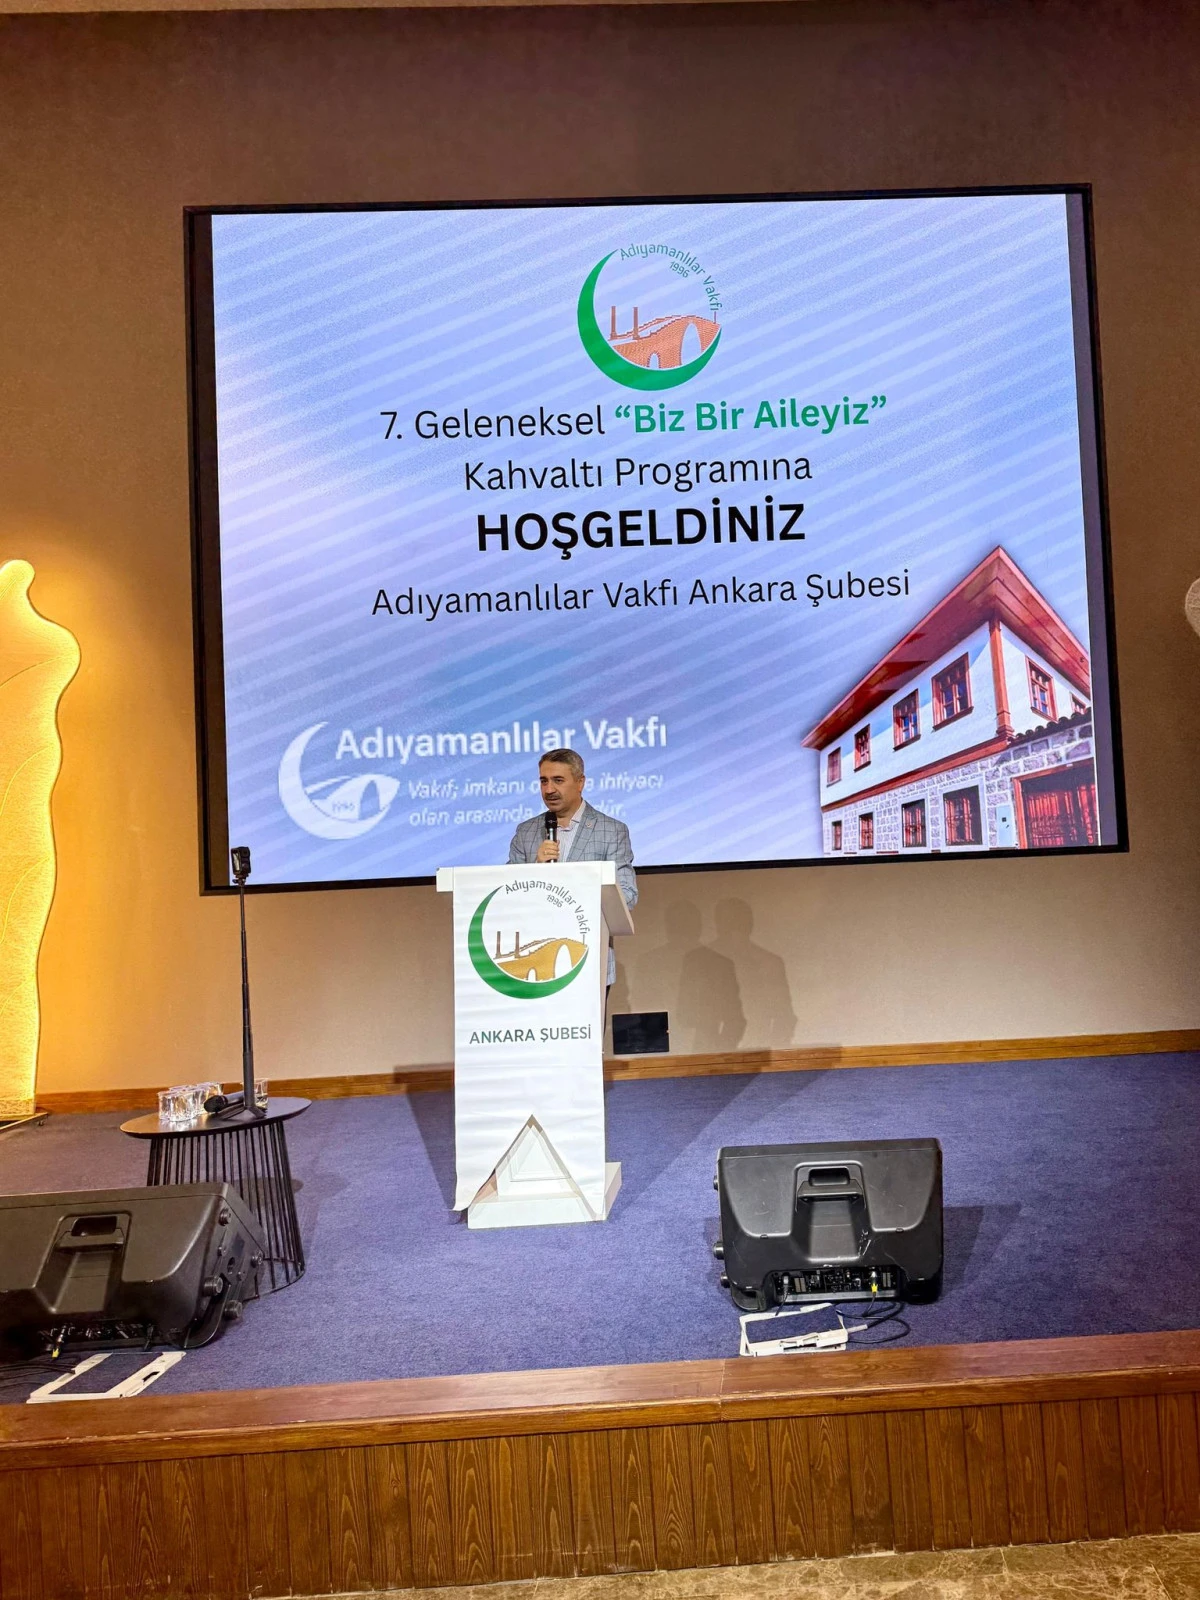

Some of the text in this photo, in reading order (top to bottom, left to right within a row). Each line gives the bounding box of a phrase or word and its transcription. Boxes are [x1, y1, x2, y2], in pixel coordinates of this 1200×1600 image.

[619, 243, 723, 311] Adıyamanlılar Vakfı
[669, 261, 690, 278] 1996
[380, 395, 887, 440] 7. Geleneksel “Biz Bir Aileyiz”
[465, 455, 813, 493] Kahvaltı Programına
[477, 495, 806, 561] HOŞGELDİNİZ
[372, 568, 910, 622] Adıyamanlılar Vakfı Ankara Şubesi
[335, 716, 668, 765] Adıyamanlılar Vakfı
[409, 807, 450, 826] olan
[504, 879, 591, 935] Adıyamanlılar Vakfı
[546, 894, 565, 909] 1996
[469, 1023, 592, 1045] ANKARA ŞUBESİ
